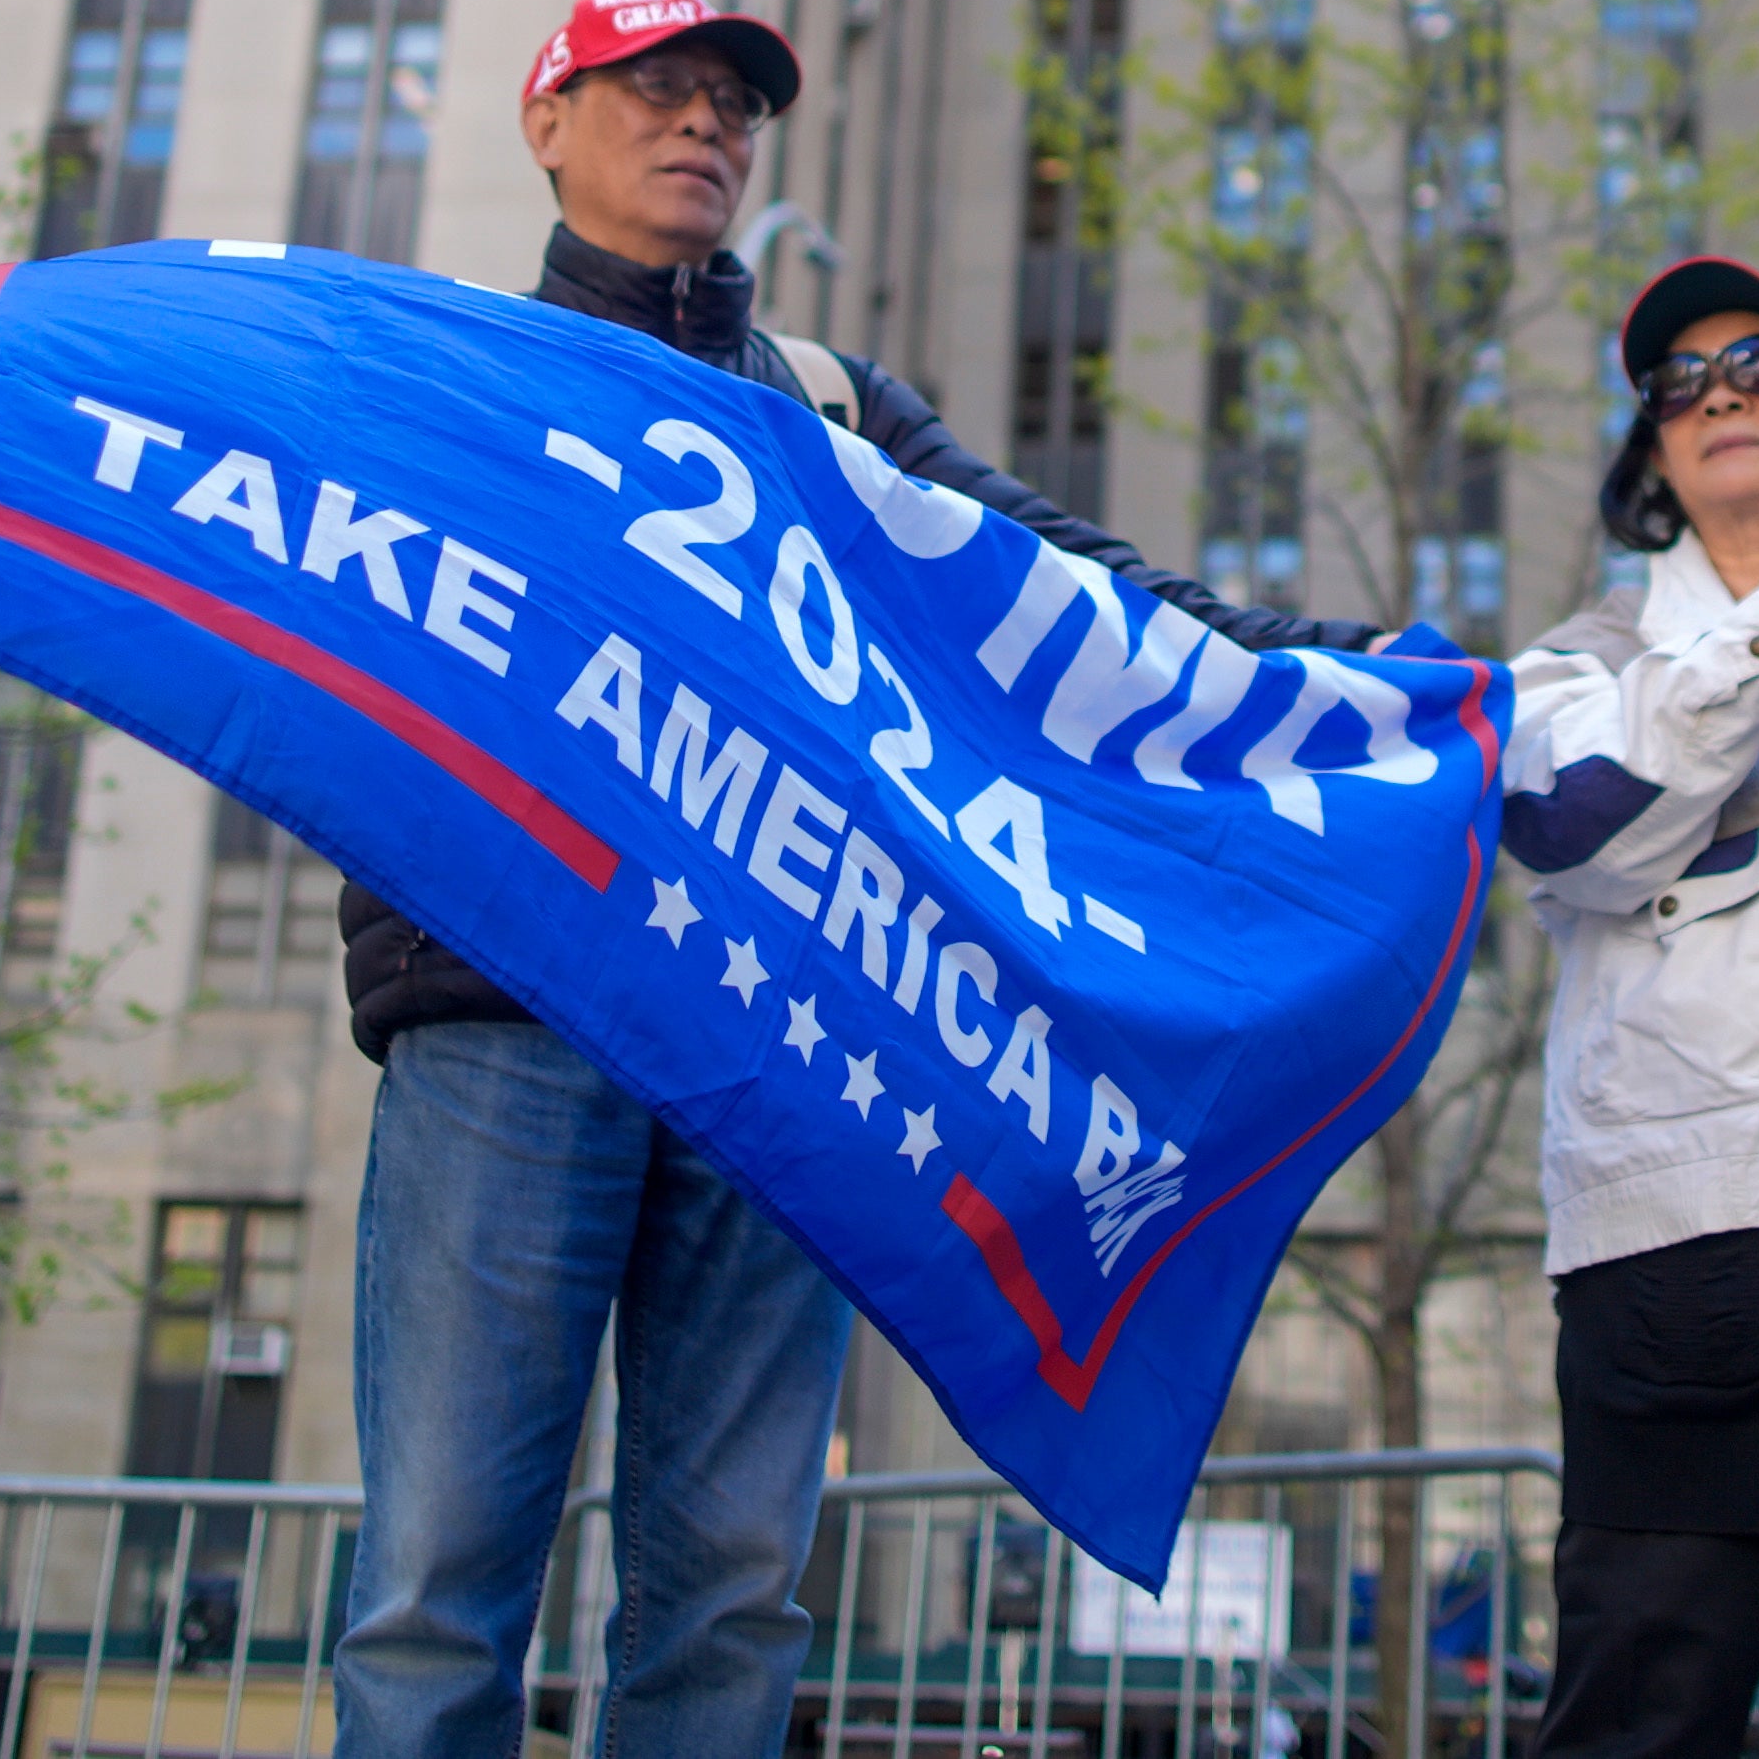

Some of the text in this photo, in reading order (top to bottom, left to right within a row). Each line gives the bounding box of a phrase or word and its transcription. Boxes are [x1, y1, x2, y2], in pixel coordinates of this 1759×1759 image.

[613, 1, 697, 32] GREAT
[74, 397, 528, 678] TAKE
[555, 632, 1054, 1145] AMERICA
